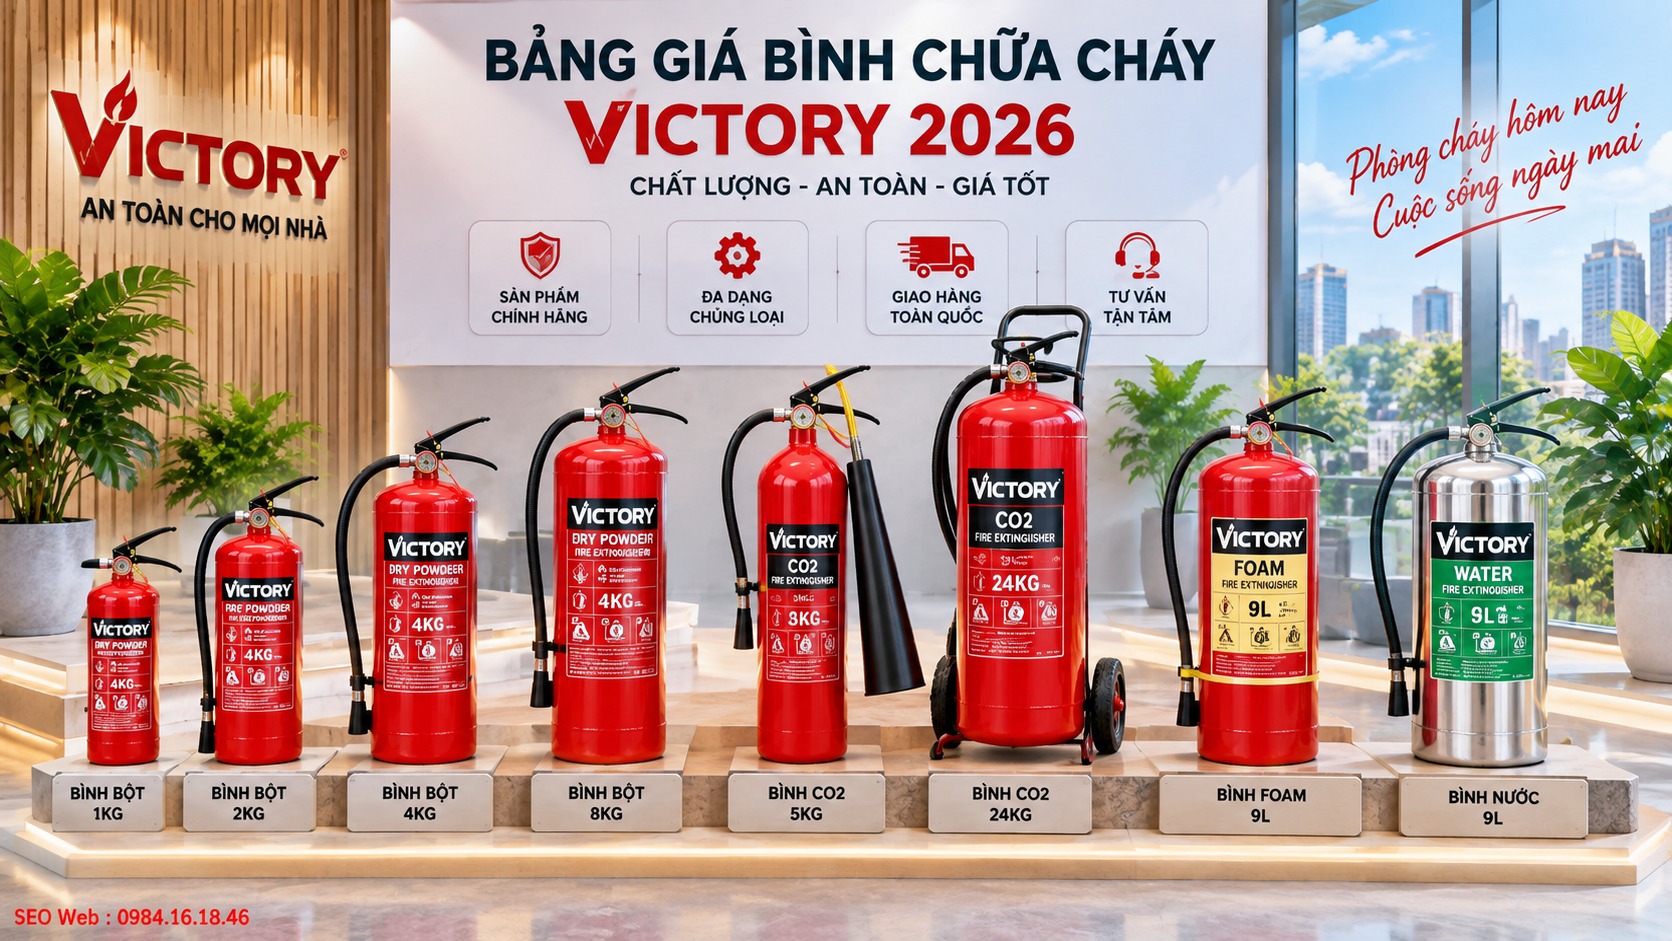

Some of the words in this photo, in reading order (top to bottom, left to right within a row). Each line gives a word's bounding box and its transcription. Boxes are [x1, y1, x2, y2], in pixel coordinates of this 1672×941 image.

[485, 23, 636, 82] BẢNG
[653, 27, 747, 82] GIÁ
[764, 27, 894, 82] BÌNH
[912, 27, 1062, 82] CHỮA
[1077, 27, 1216, 82] CHÁY
[1438, 117, 1500, 164] cháy
[1506, 98, 1565, 139] hôm
[1573, 83, 1628, 124] nay
[563, 99, 891, 165] VICTORY
[909, 102, 1075, 157] 2026
[630, 170, 697, 196] CHẤT
[704, 174, 791, 200] LƯỢNG
[816, 176, 851, 196] AN
[859, 172, 927, 196] TOÀN
[952, 172, 996, 196] GIÁ
[1003, 169, 1050, 196] TỐT
[1373, 192, 1437, 239] Cuộc
[1445, 168, 1503, 214] sống
[1511, 149, 1579, 200] ngày
[1588, 122, 1644, 165] mai
[81, 197, 115, 221] AN
[122, 199, 183, 227] TOÀN
[190, 207, 236, 231] CHO
[242, 213, 280, 240] MỌI
[286, 216, 328, 240] NHÀ
[702, 290, 723, 303] ĐA
[728, 290, 772, 306] DẠNG
[892, 290, 931, 303] GIAO
[936, 287, 981, 303] HÀNG
[1109, 289, 1130, 303] TƯ
[491, 308, 540, 323] CHÍNH
[750, 311, 784, 327] LOẠI
[890, 307, 933, 323] TOÀN
[970, 477, 1059, 500] VICTORY
[571, 504, 653, 525] VICTORY
[995, 511, 1033, 529] CO2
[769, 531, 836, 550] VICTORY
[975, 532, 992, 543] FIRE
[1216, 526, 1304, 549] VICTORY
[1436, 529, 1531, 556] VICTORY
[388, 537, 464, 557] VICTORY
[788, 558, 818, 573] CO2
[1234, 560, 1284, 576] FOAM
[1454, 565, 1513, 582] WATER
[225, 583, 292, 598] VICTORY
[992, 574, 1040, 592] 24KG
[1222, 580, 1238, 589] FIRE
[1442, 584, 1460, 595] FIRE
[597, 593, 634, 609] 4KG
[1248, 600, 1272, 618] 9L
[93, 622, 150, 637] VICTORY
[411, 617, 444, 632] 4KG
[243, 648, 273, 661] 4KG
[110, 679, 134, 690] 4KG
[70, 783, 108, 800] BÌNH
[113, 783, 145, 803] BỘT
[211, 783, 250, 800] BÌNH
[254, 783, 287, 803] BỘT
[382, 782, 421, 799] BÌNH
[426, 783, 458, 803] BỘT
[568, 782, 607, 799] BÌNH
[612, 783, 645, 803] BỘT
[768, 782, 807, 800] BÌNH
[812, 786, 846, 800] CO2
[972, 783, 1011, 800] BÌNH
[1016, 786, 1050, 801] CO2
[1217, 785, 1256, 802] BÌNH
[1260, 788, 1307, 802] FOAM
[1448, 787, 1488, 804] BÌNH
[1492, 787, 1540, 805] NƯỚC
[94, 807, 123, 820] 1KG
[232, 807, 265, 820] 2KG
[403, 806, 436, 820] 4KG
[590, 806, 623, 820] 8KG
[790, 807, 823, 821] 5KG
[989, 807, 1032, 821] 24KG
[1250, 809, 1271, 823] 9L
[1482, 811, 1504, 825] 9L
